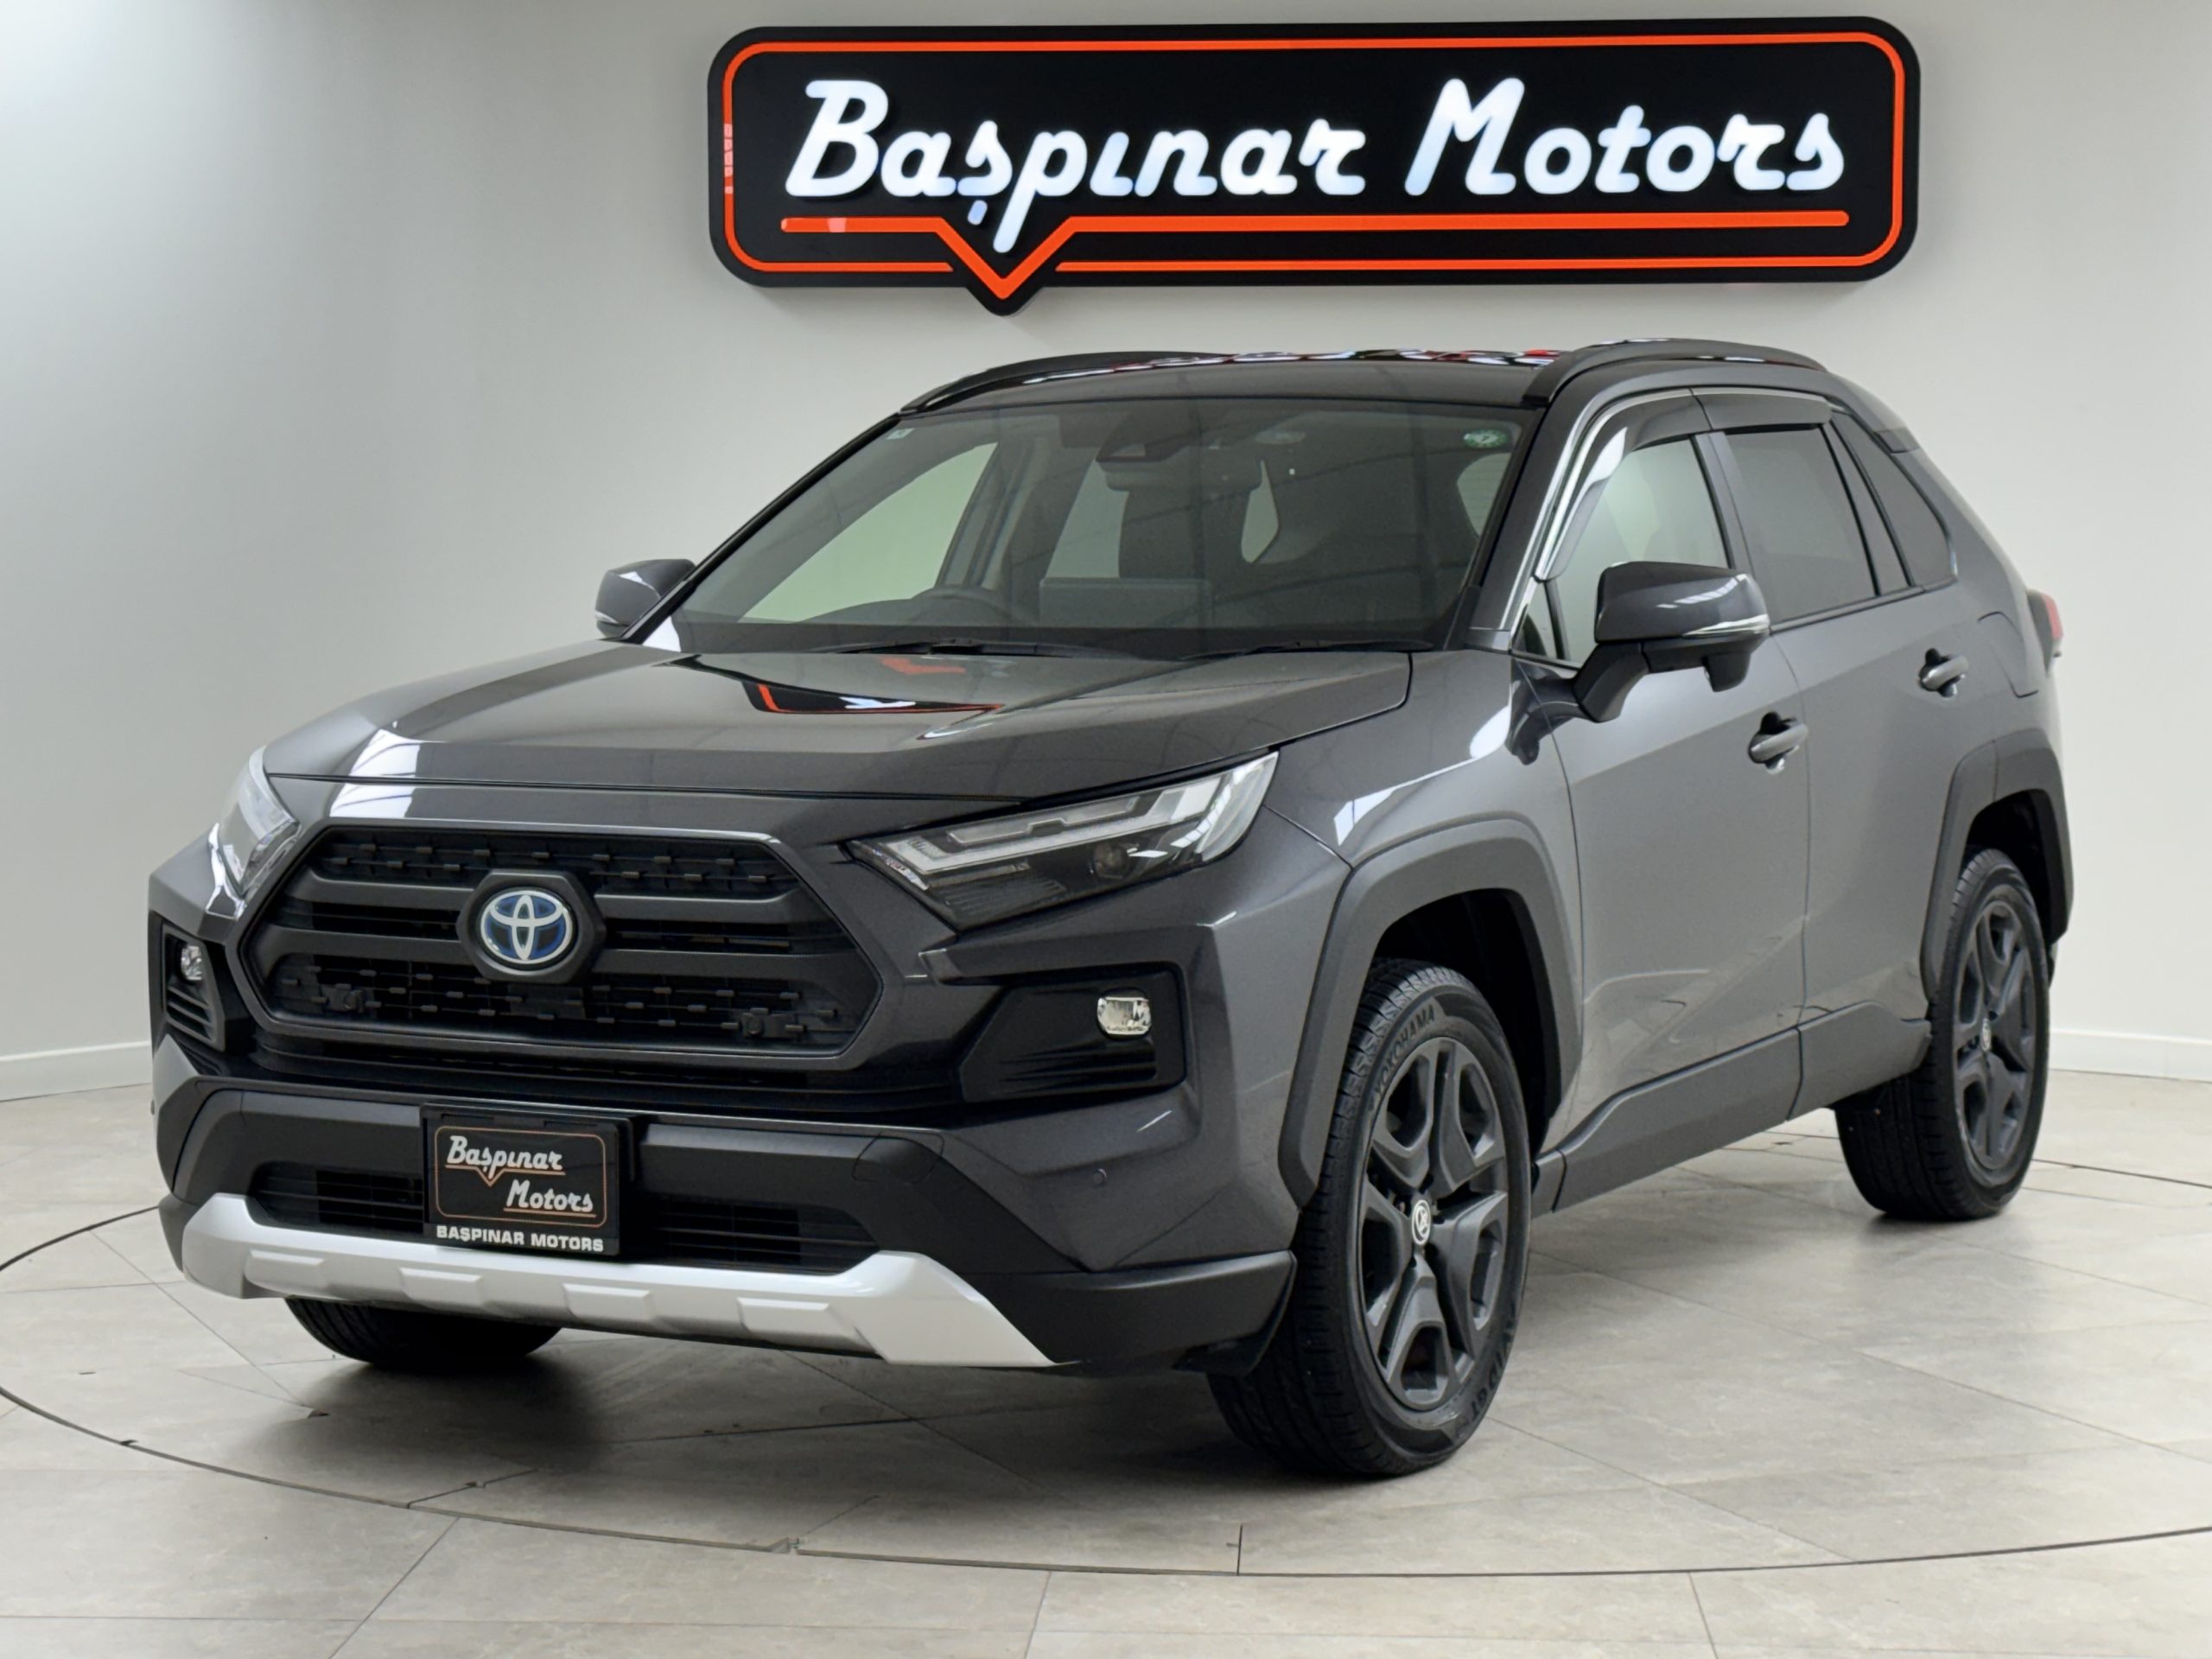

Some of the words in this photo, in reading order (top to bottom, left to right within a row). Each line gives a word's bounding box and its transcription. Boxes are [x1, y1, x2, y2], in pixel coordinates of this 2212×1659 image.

[1404, 77, 1845, 197] Motors
[1375, 1003, 1435, 1096] YOKOHAMA
[505, 1179, 594, 1213] Motors
[531, 1232, 605, 1253] MOTORS
